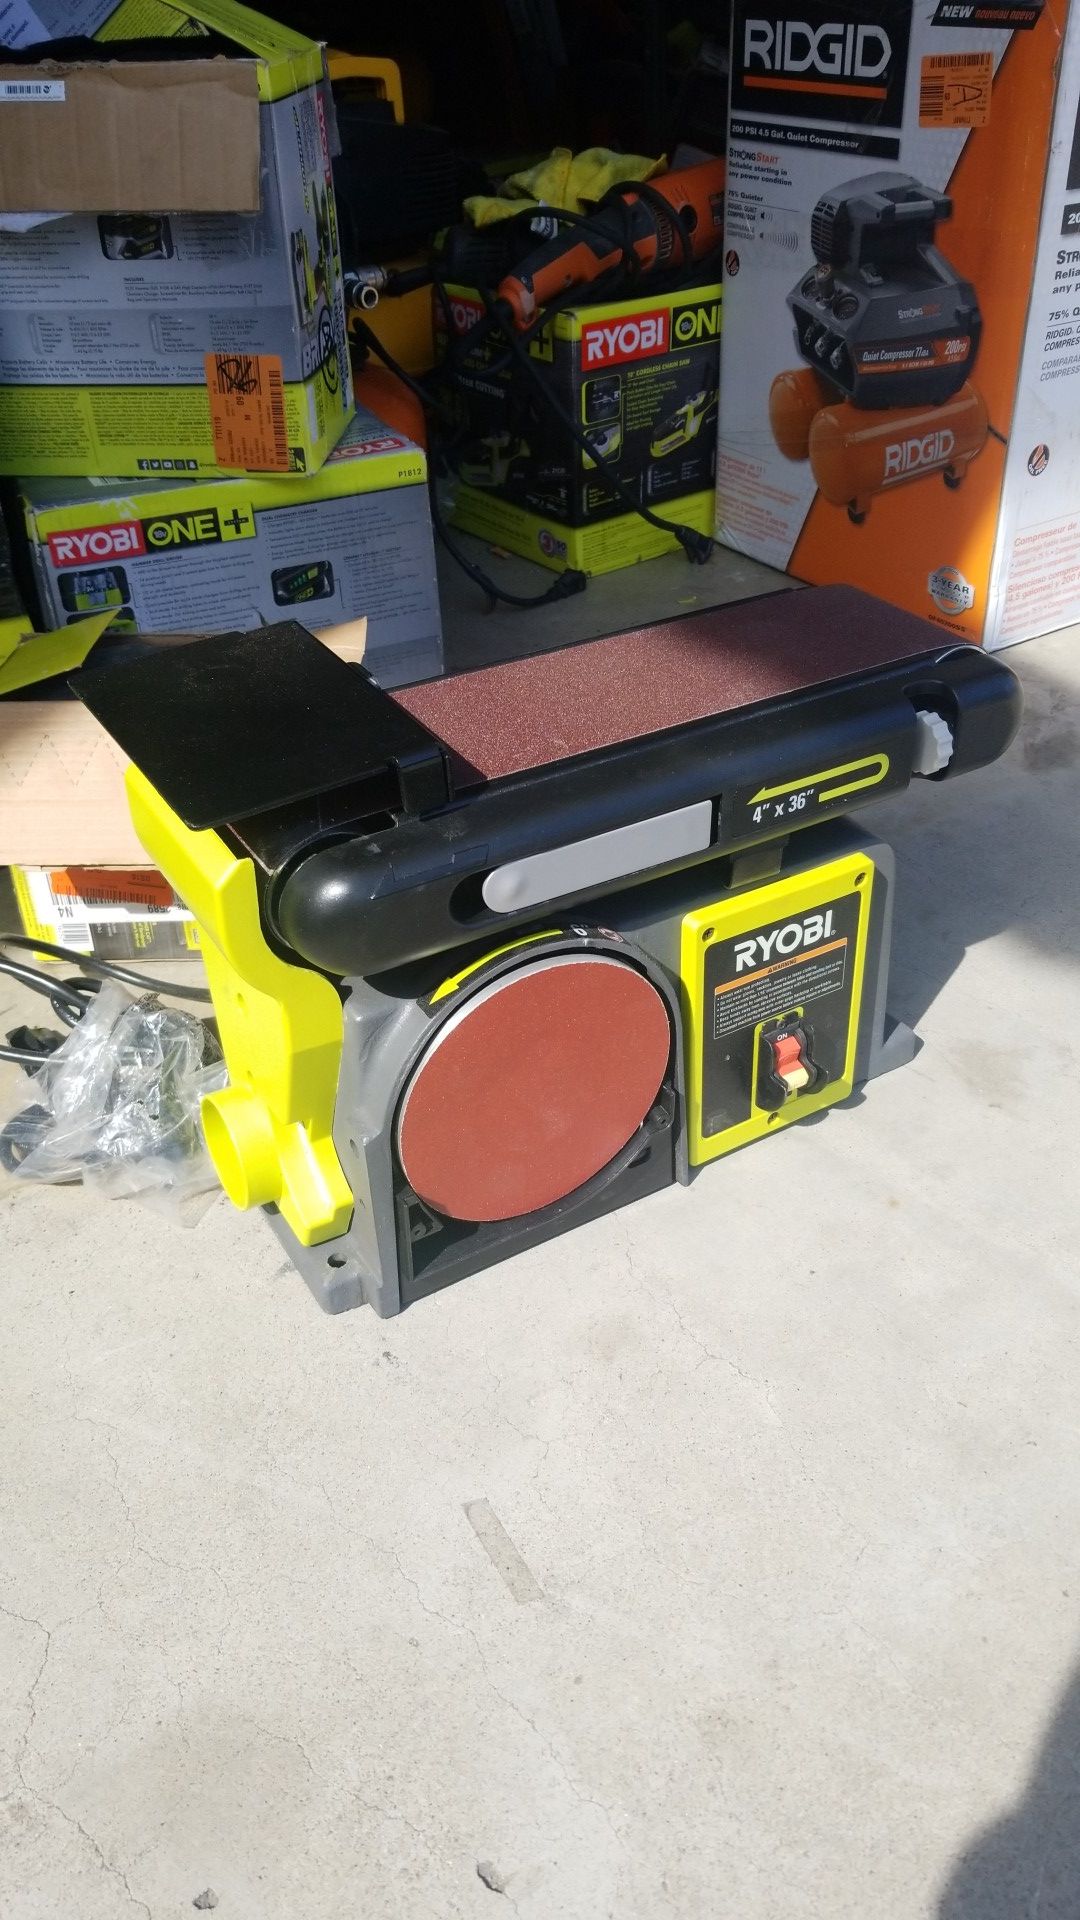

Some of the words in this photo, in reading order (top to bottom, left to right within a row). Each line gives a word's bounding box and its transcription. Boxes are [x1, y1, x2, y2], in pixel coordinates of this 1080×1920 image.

[940, 6, 974, 18] NEW
[744, 19, 892, 78] RIDGID
[732, 125, 744, 133] 200
[745, 126, 757, 136] PSI
[758, 128, 770, 136] 4.5
[787, 132, 808, 142] Quiet
[810, 134, 859, 148] Compressor
[754, 164, 779, 176] starting
[780, 168, 788, 176] in
[740, 173, 760, 182] power
[762, 176, 792, 186] condition
[740, 192, 763, 201] Quieter
[1052, 284, 1072, 294] any
[1049, 309, 1069, 321] 75%
[586, 316, 664, 362] RYOBI
[1046, 327, 1072, 340] RIDGID
[863, 351, 879, 361] Quiet
[880, 348, 915, 361] Compressor
[636, 364, 661, 377] CORDLESS
[662, 361, 678, 371] CHAIN
[679, 358, 690, 368] SAW
[884, 428, 954, 476] RIDGID
[398, 468, 422, 478] P1812
[1014, 526, 1065, 547] Compresseur
[1068, 521, 1077, 530] de
[52, 527, 141, 560] RYOBI
[932, 575, 969, 594] 3-YEAR
[752, 803, 770, 824] 4"
[774, 802, 784, 817] x
[788, 789, 815, 813] 36"
[734, 909, 833, 972] RYOBI
[773, 958, 797, 971] WARNING
[777, 1033, 788, 1041] ON
